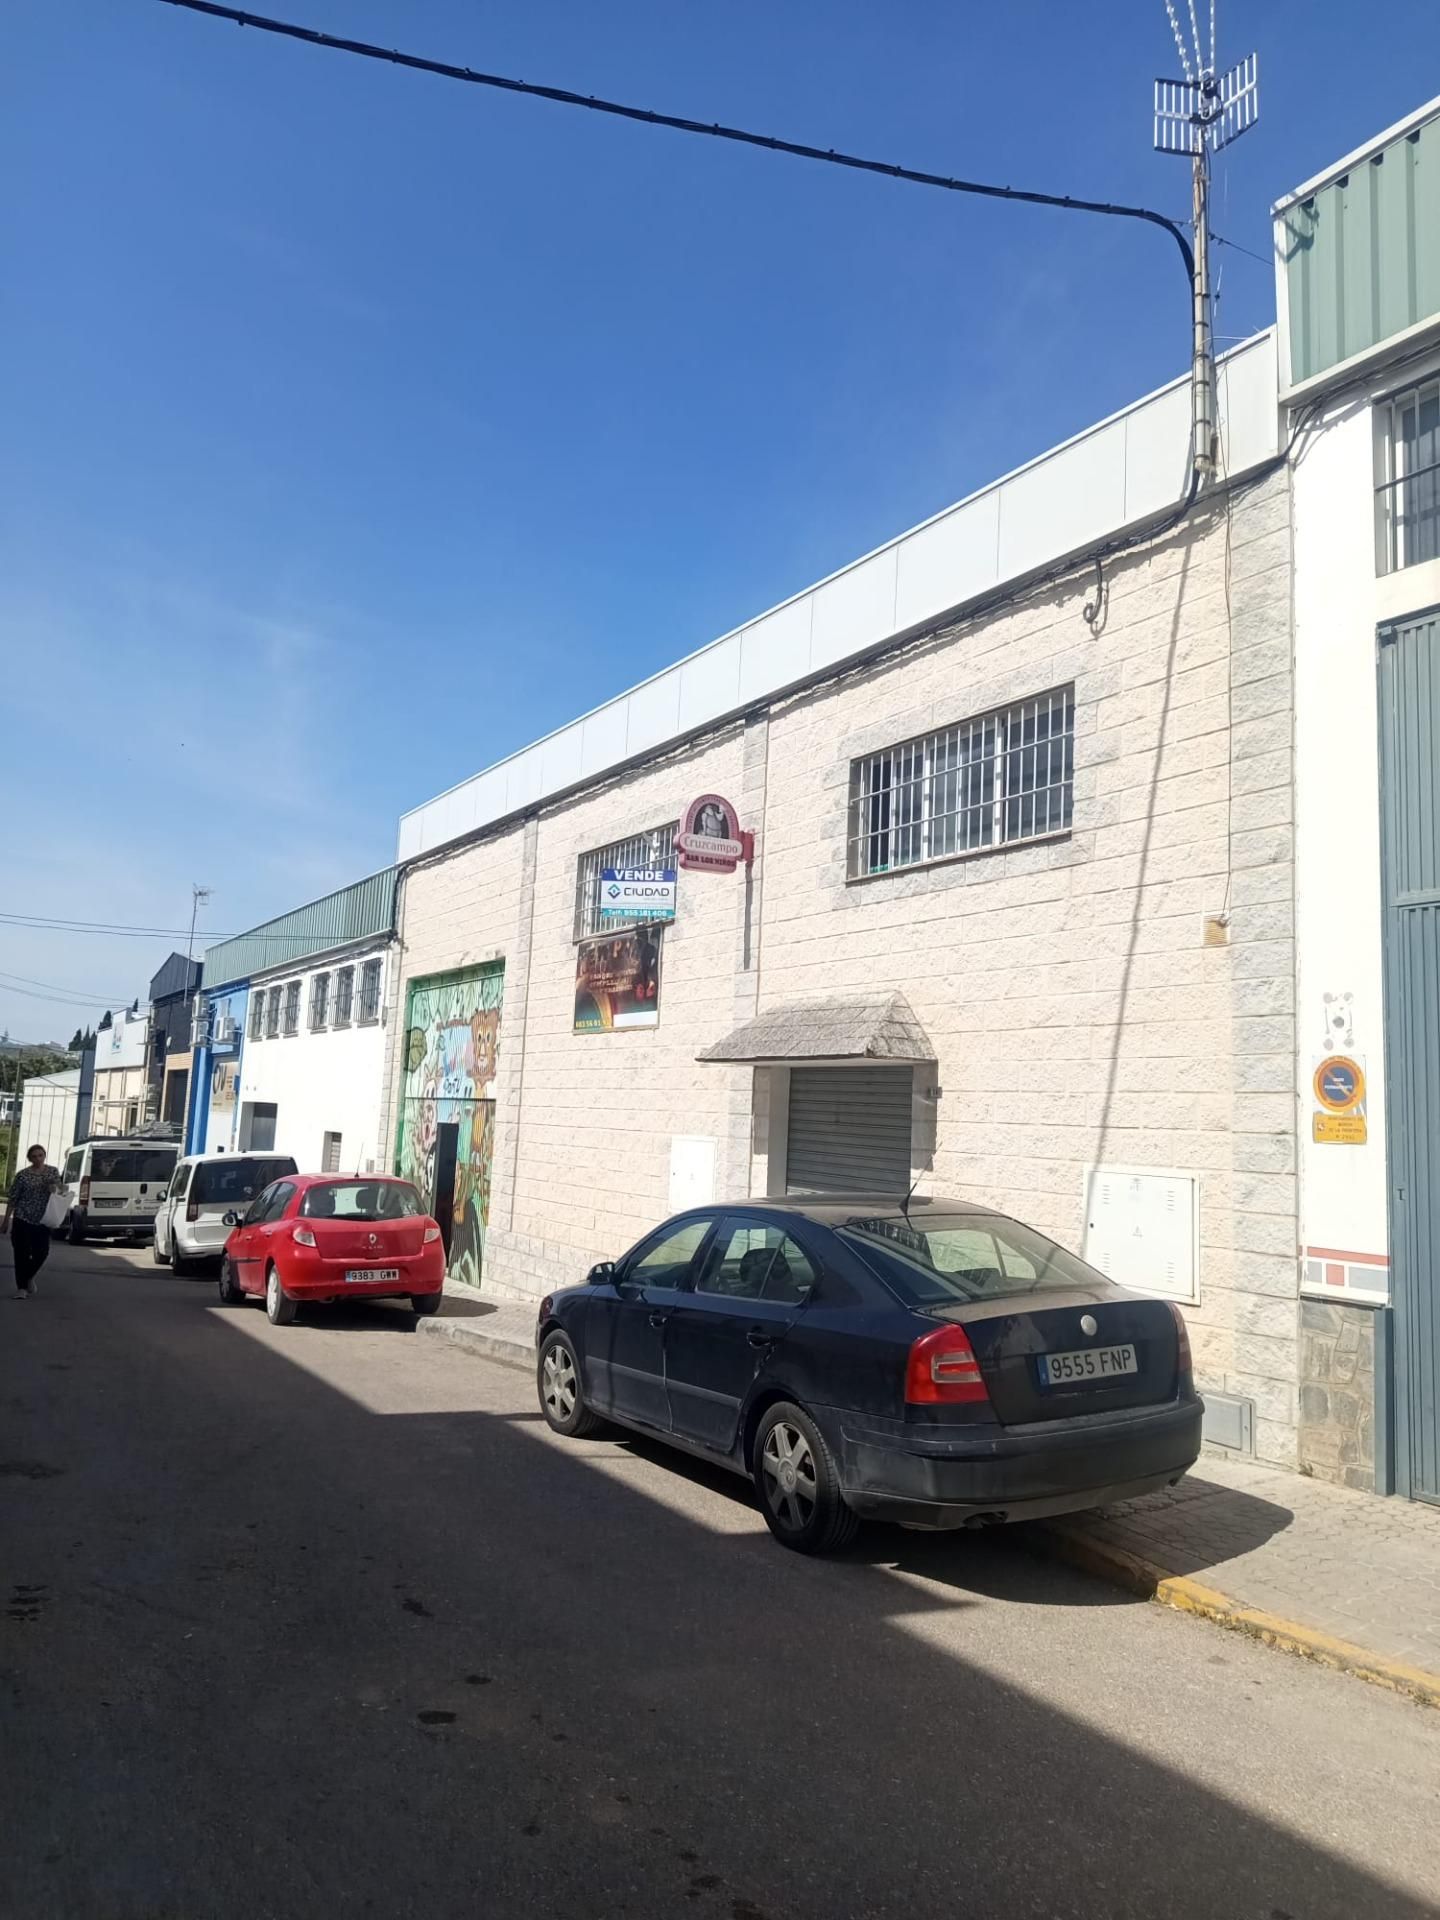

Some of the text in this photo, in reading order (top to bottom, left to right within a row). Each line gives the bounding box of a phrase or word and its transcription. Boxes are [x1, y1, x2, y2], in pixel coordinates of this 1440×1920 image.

[684, 836, 738, 854] Cruzcampo
[614, 870, 664, 880] VENDE
[624, 888, 670, 896] CIUDAD
[352, 1271, 397, 1281] 9383 GWW
[1051, 1349, 1131, 1379] 9555 FNP
